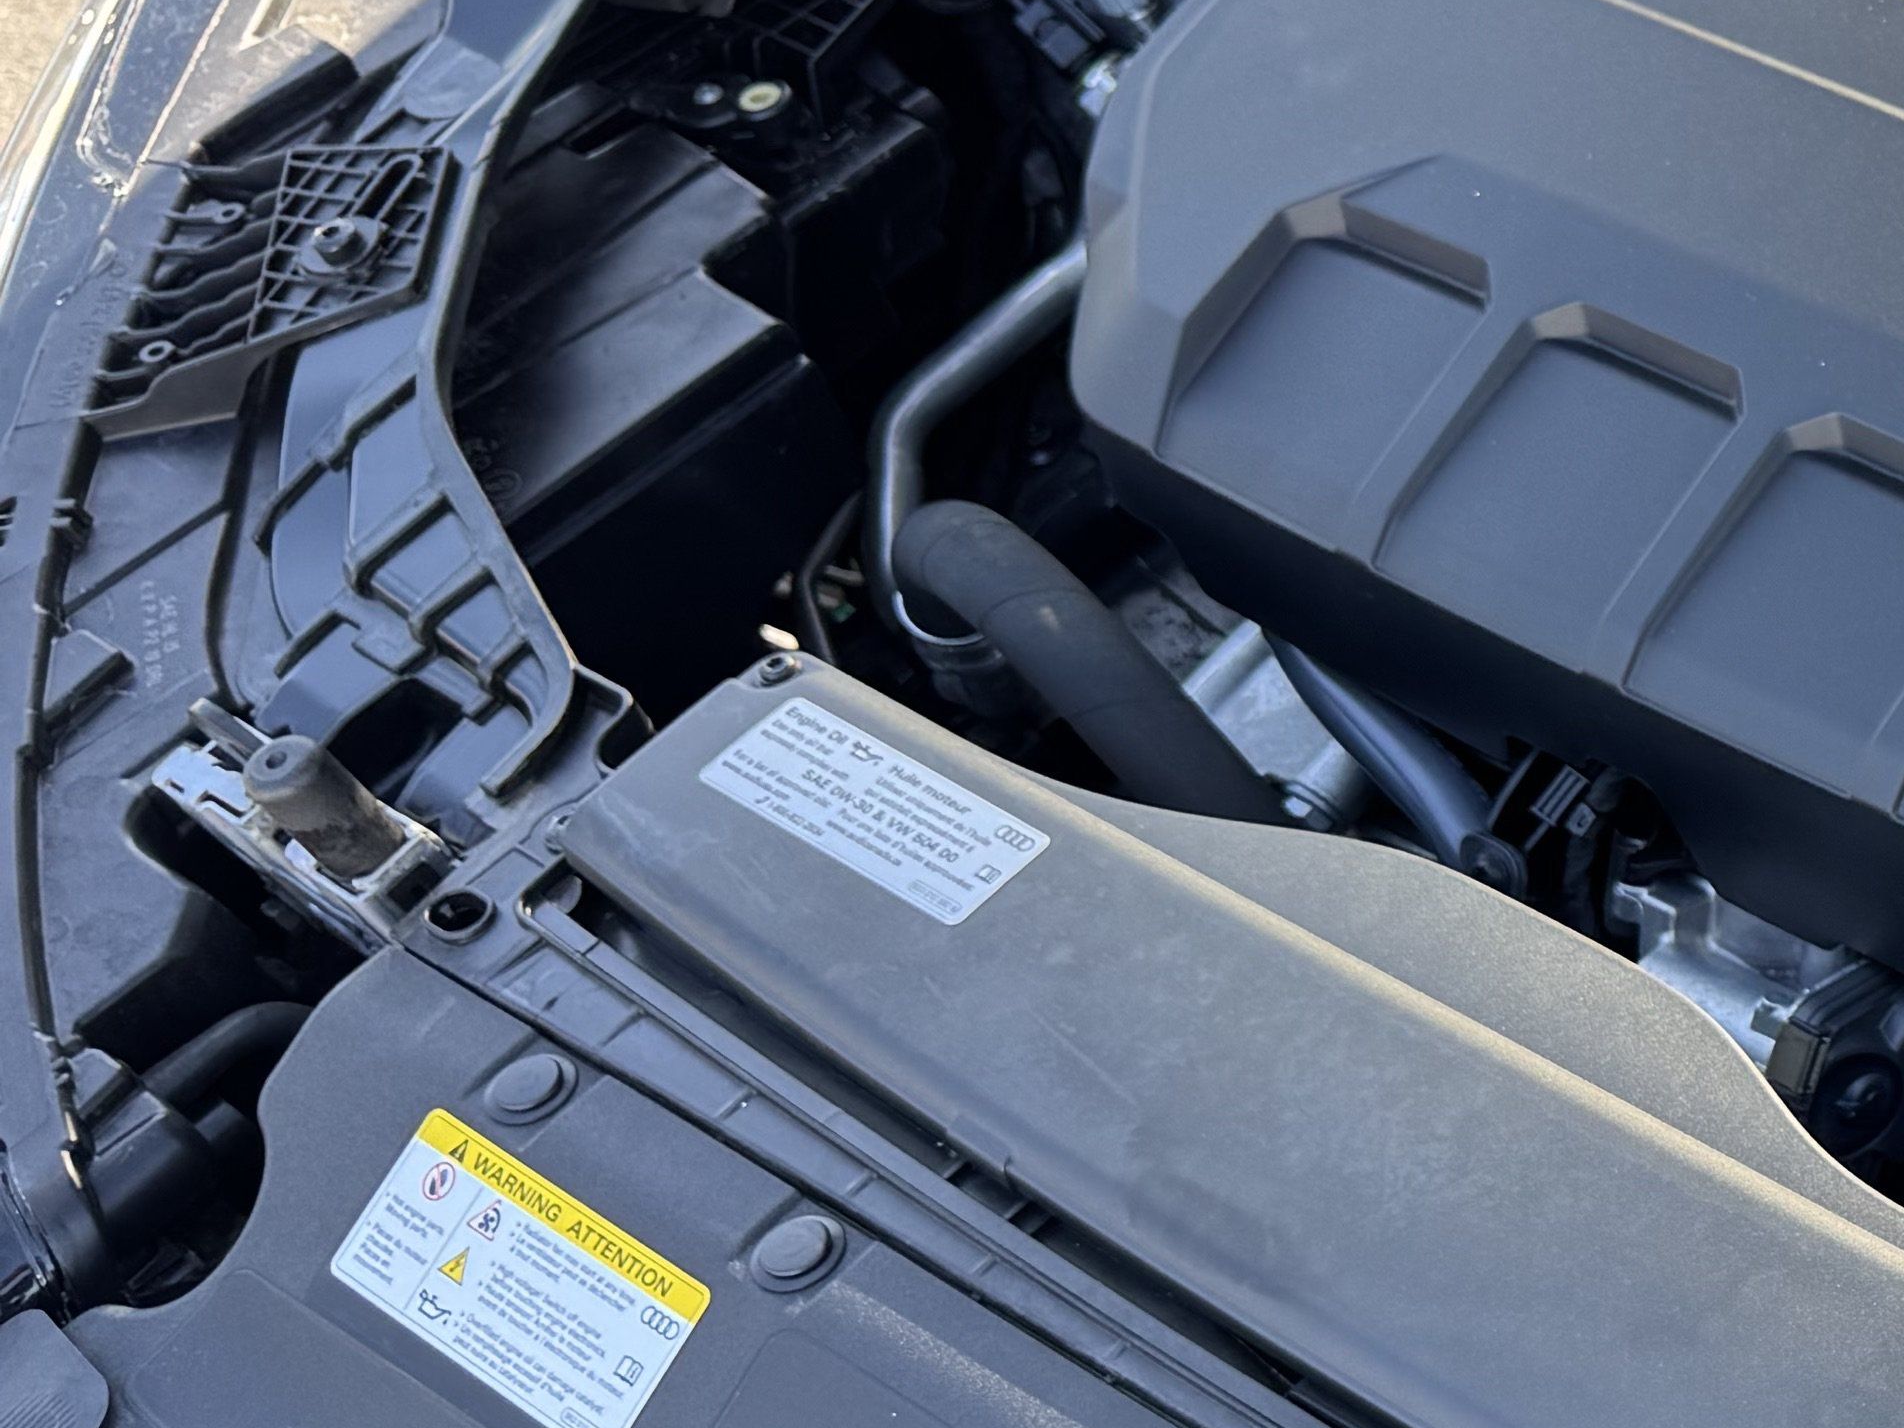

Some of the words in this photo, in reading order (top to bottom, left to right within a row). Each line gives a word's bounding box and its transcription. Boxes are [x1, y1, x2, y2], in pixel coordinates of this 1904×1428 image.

[785, 707, 827, 733] Engine
[827, 730, 848, 744] Oil
[801, 769, 832, 789] SAE
[830, 786, 873, 814] 0W-30
[887, 817, 915, 836] VW
[938, 848, 959, 862] 00
[888, 765, 921, 787] Huile
[922, 785, 971, 814] moteur
[474, 1153, 561, 1222] WARNING
[567, 1221, 672, 1296] ATTENTION
